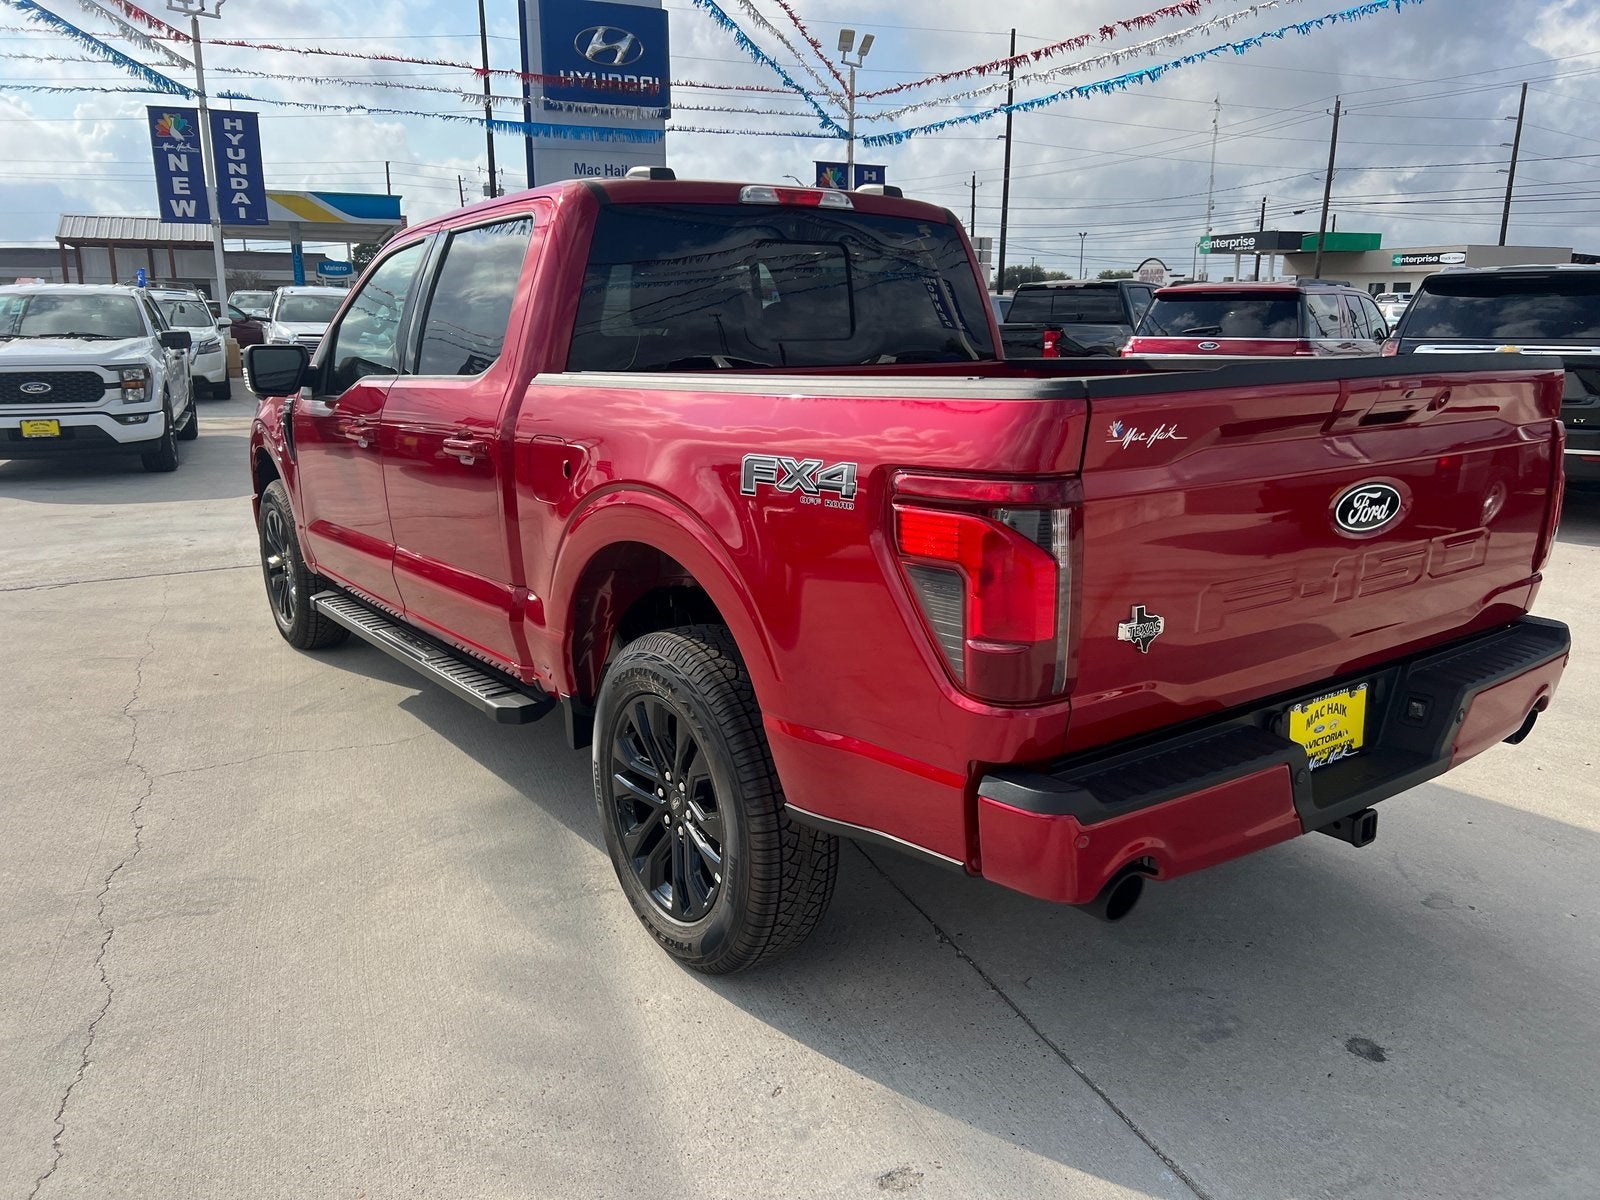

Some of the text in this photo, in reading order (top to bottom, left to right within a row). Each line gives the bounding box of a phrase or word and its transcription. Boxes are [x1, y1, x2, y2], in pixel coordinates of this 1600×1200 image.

[223, 118, 252, 219] HYUNDAI
[574, 163, 628, 178] Mac Hai
[167, 153, 196, 218] NEW
[1202, 235, 1256, 250] enterprise
[1394, 255, 1439, 264] enterprise
[740, 453, 857, 501] FX4
[799, 495, 855, 511] OFF ROAD
[1346, 490, 1393, 525] Ford
[1127, 620, 1163, 639] TEXAS
[1305, 705, 1326, 730] MAC
[1326, 702, 1348, 718] HAIK
